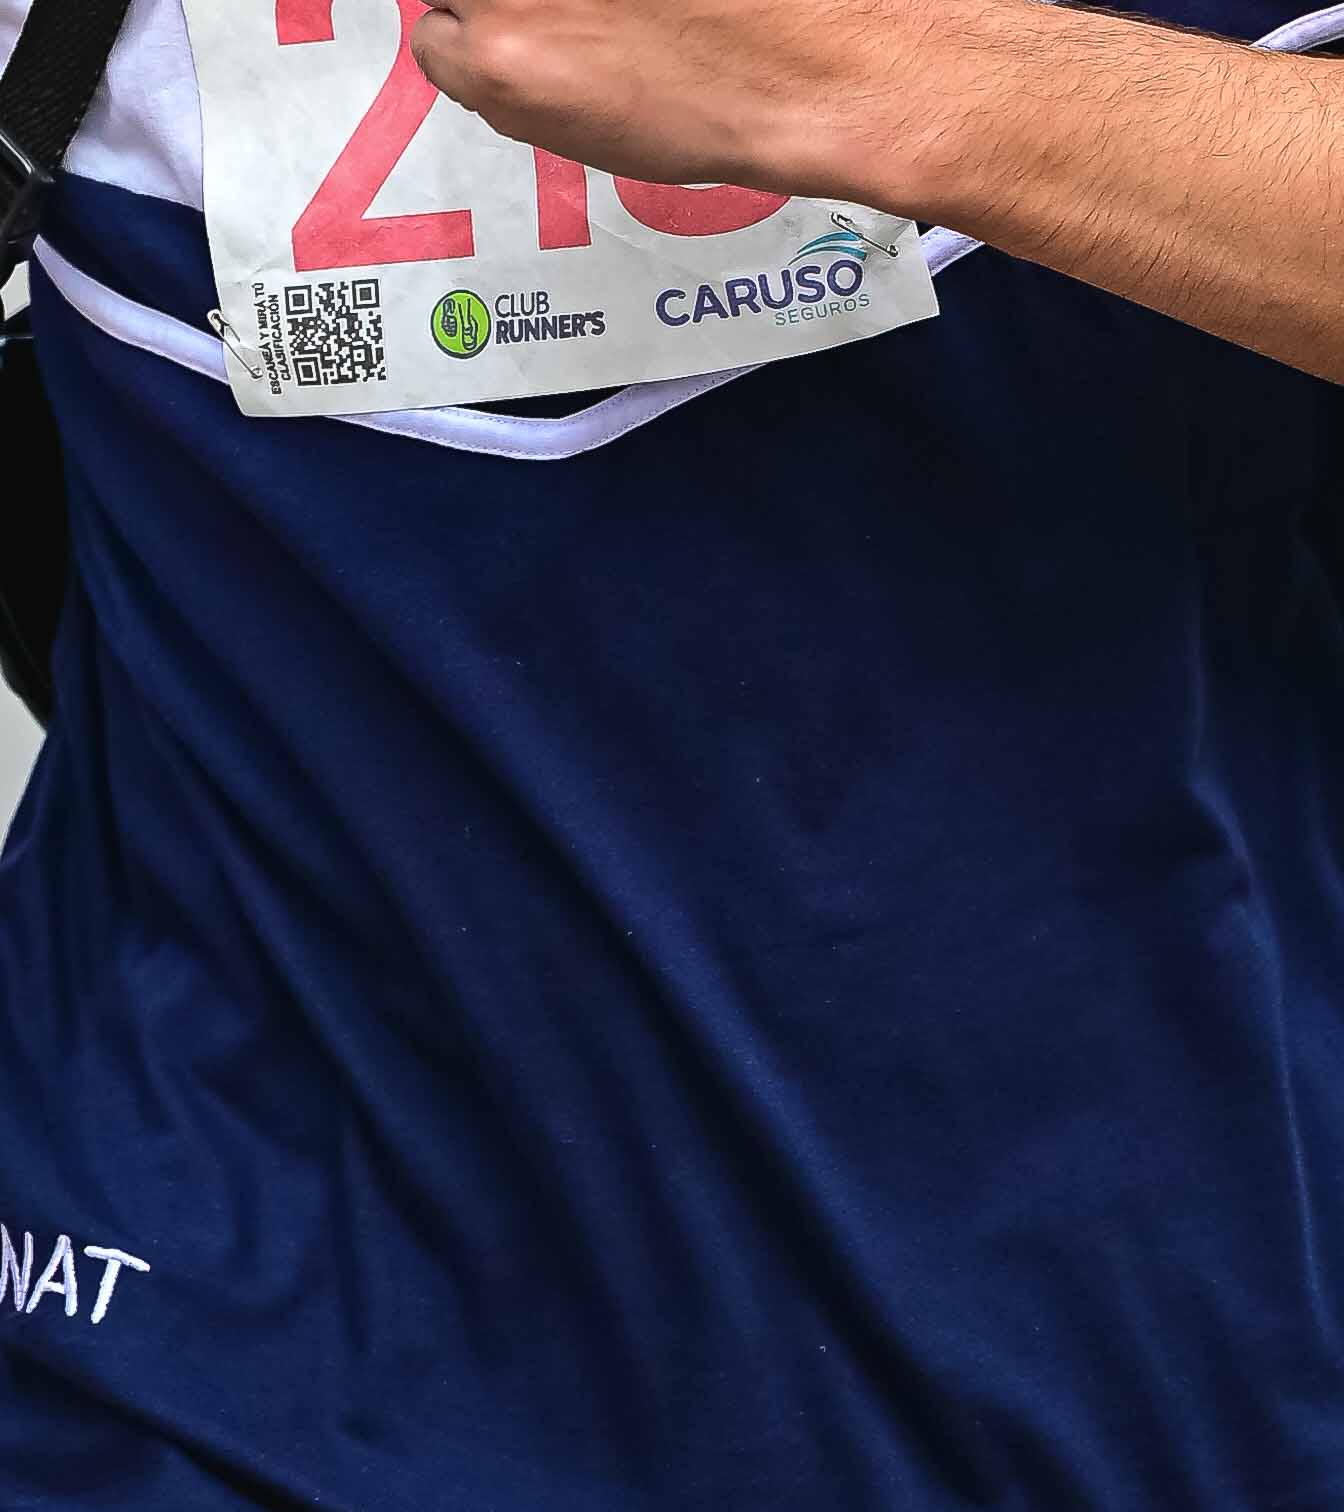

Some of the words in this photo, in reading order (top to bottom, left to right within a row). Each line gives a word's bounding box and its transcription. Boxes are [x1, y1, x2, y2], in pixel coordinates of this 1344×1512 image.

[251, 283, 264, 298] TÚ
[494, 291, 550, 318] CLUB
[655, 259, 864, 327] CARUSO
[774, 293, 871, 326] SEGUROS
[259, 332, 269, 340] Y
[267, 294, 292, 381] CLASIFICACIÓN
[495, 311, 606, 345] RUNNER'S
